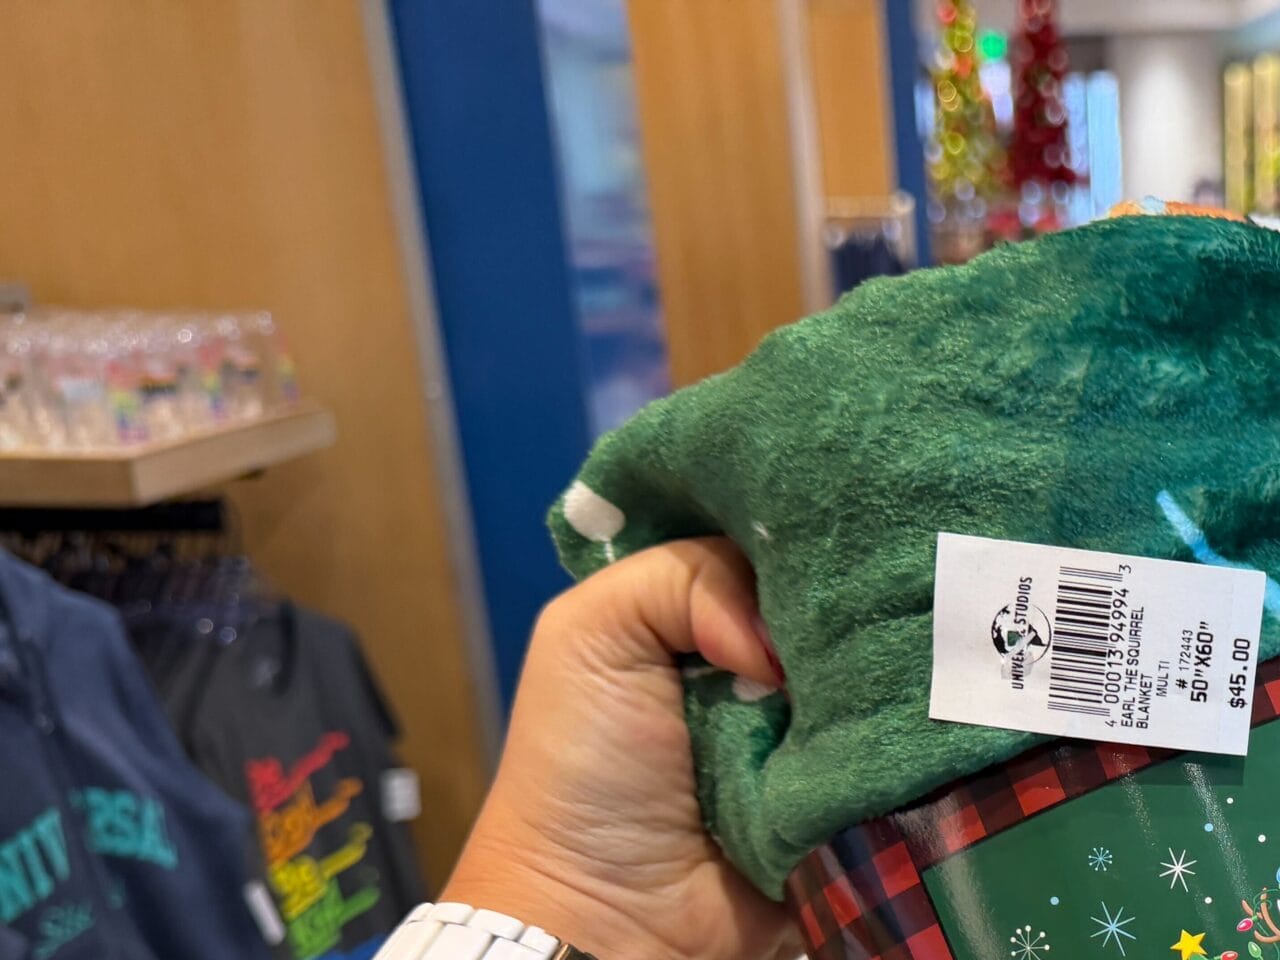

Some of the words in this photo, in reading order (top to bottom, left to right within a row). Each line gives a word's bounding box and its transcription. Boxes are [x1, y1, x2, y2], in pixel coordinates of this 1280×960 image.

[1014, 576, 1033, 625] STUDIOS
[1011, 628, 1028, 690] UNIVE
[1105, 719, 1118, 728] 4
[1118, 564, 1132, 574] 3
[1127, 606, 1144, 666] SQUIRREL
[1178, 629, 1193, 671] 172443
[1190, 621, 1214, 703] 50"X60"
[1124, 668, 1138, 692] THE
[1136, 673, 1153, 729] BLANKET
[1156, 660, 1170, 698] MULTI
[1227, 638, 1251, 709] $45.00
[1120, 696, 1136, 728] EARL
